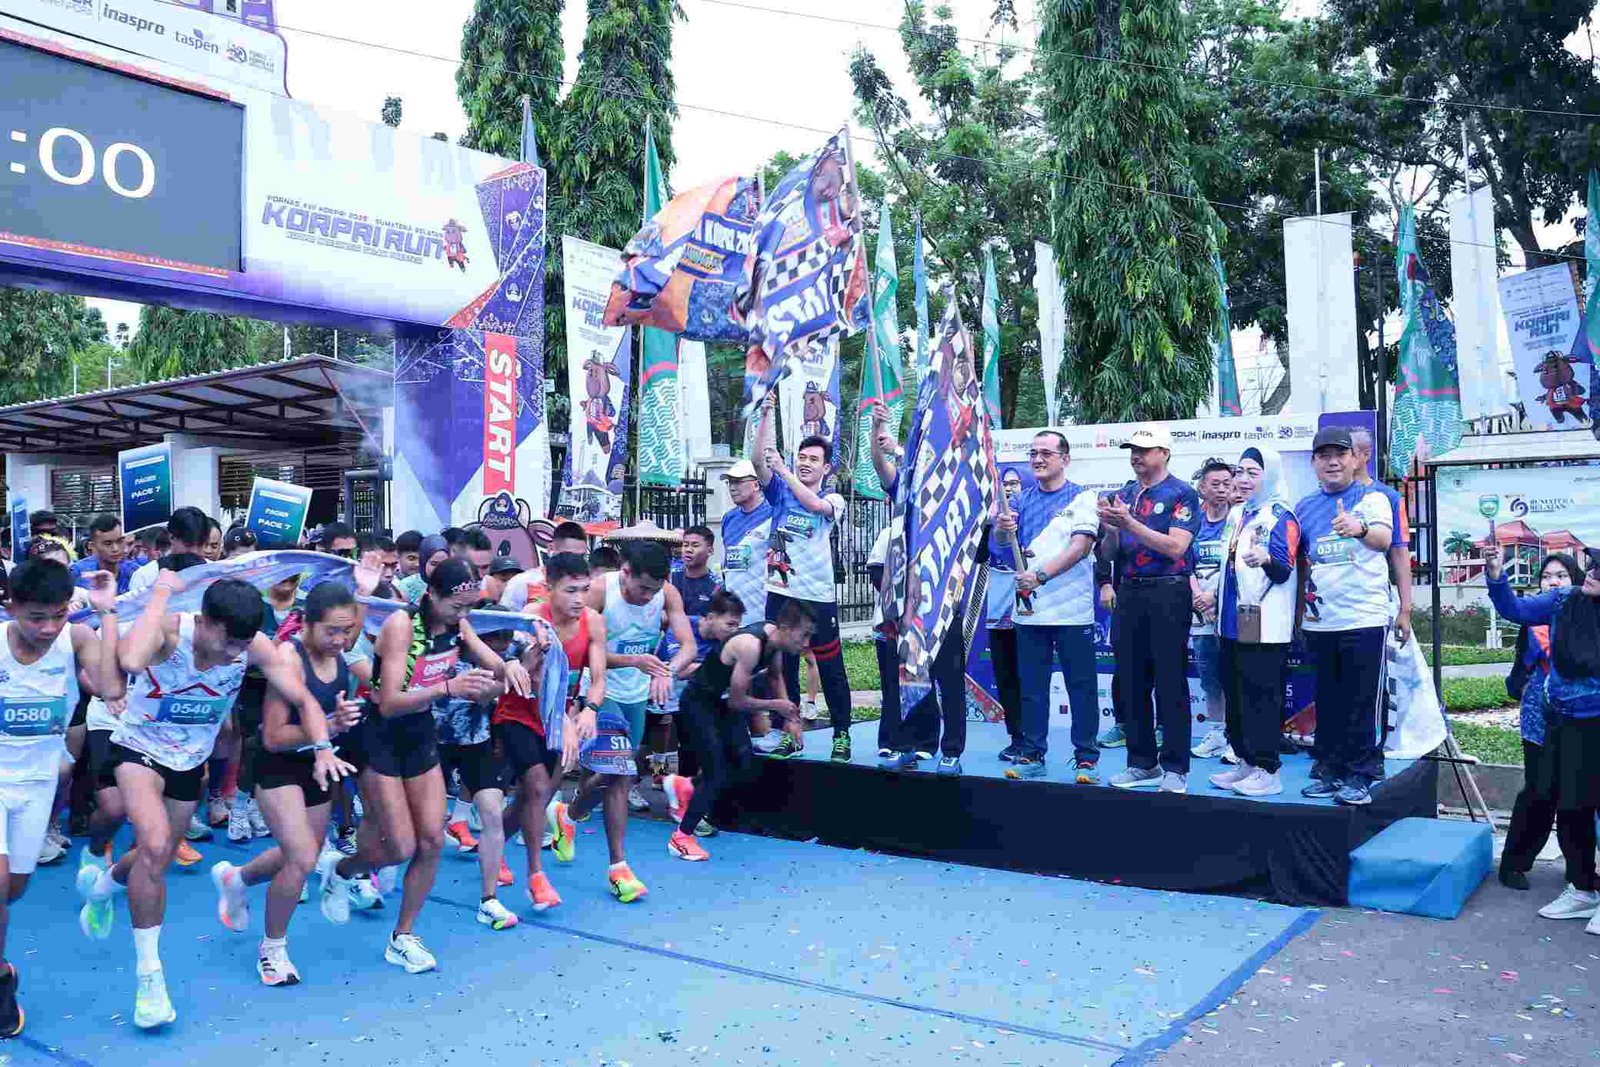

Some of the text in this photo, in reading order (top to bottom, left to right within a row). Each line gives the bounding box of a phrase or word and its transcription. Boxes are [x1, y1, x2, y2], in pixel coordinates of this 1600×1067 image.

[103, 4, 165, 36] inaspro
[175, 31, 219, 54] taspen
[262, 201, 382, 247] KORPRI
[384, 228, 444, 260] RUN
[487, 347, 514, 482] START
[1202, 431, 1241, 441] inaspro
[1244, 430, 1274, 441] taspen
[131, 485, 161, 499] PACE 7
[258, 518, 283, 530] PACE
[4, 707, 51, 723] 0580
[169, 702, 211, 715] 0540
